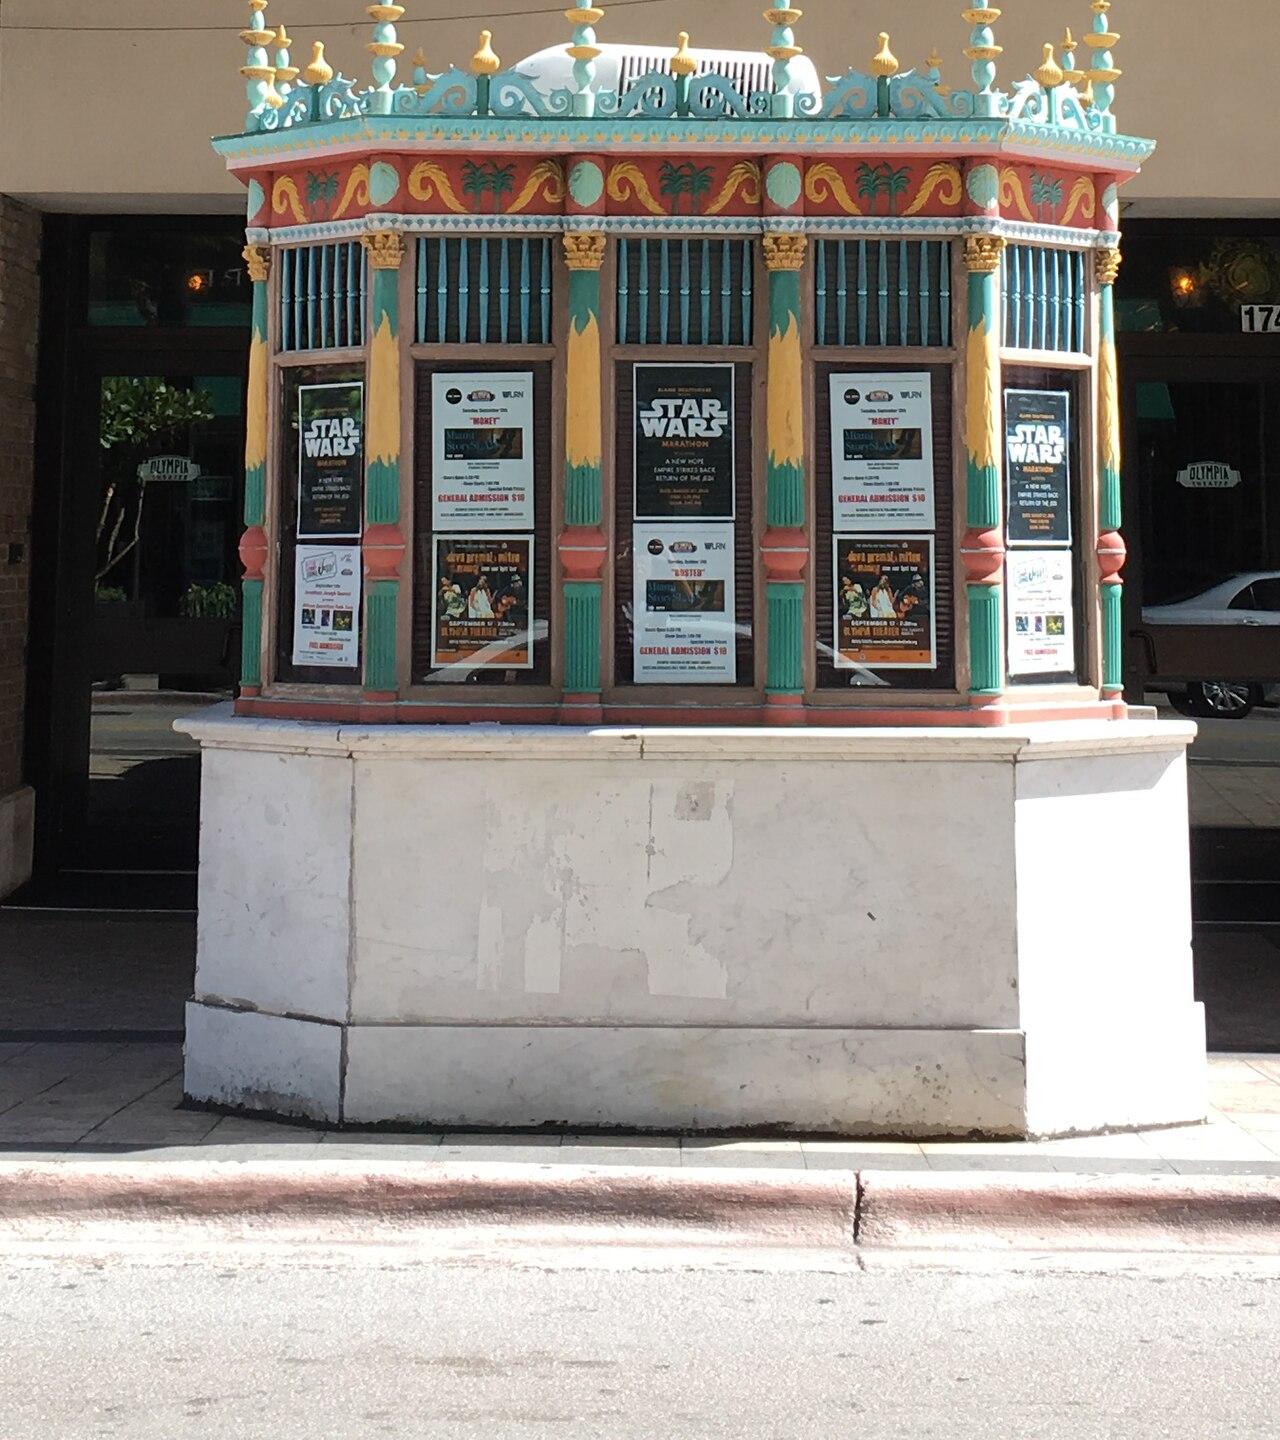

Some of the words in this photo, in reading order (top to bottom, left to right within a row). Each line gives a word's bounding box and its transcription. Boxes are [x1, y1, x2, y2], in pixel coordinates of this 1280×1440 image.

[639, 398, 728, 418] STAR
[305, 417, 360, 439] STAR
[639, 418, 728, 438] WARS
[1008, 424, 1065, 444] STAR
[305, 437, 360, 458] WARS
[661, 440, 710, 449] MARATHON
[1008, 444, 1065, 465] WARS
[150, 459, 189, 474] OLYMPIA
[1189, 465, 1230, 480] OLYMPIA
[438, 493, 467, 503] GENERAL
[469, 493, 509, 503] ADMISSION
[838, 494, 868, 503] GENERAL
[870, 494, 909, 503] ADMISSION
[639, 646, 669, 655] GENERAL
[671, 646, 711, 655] ADMISSION
